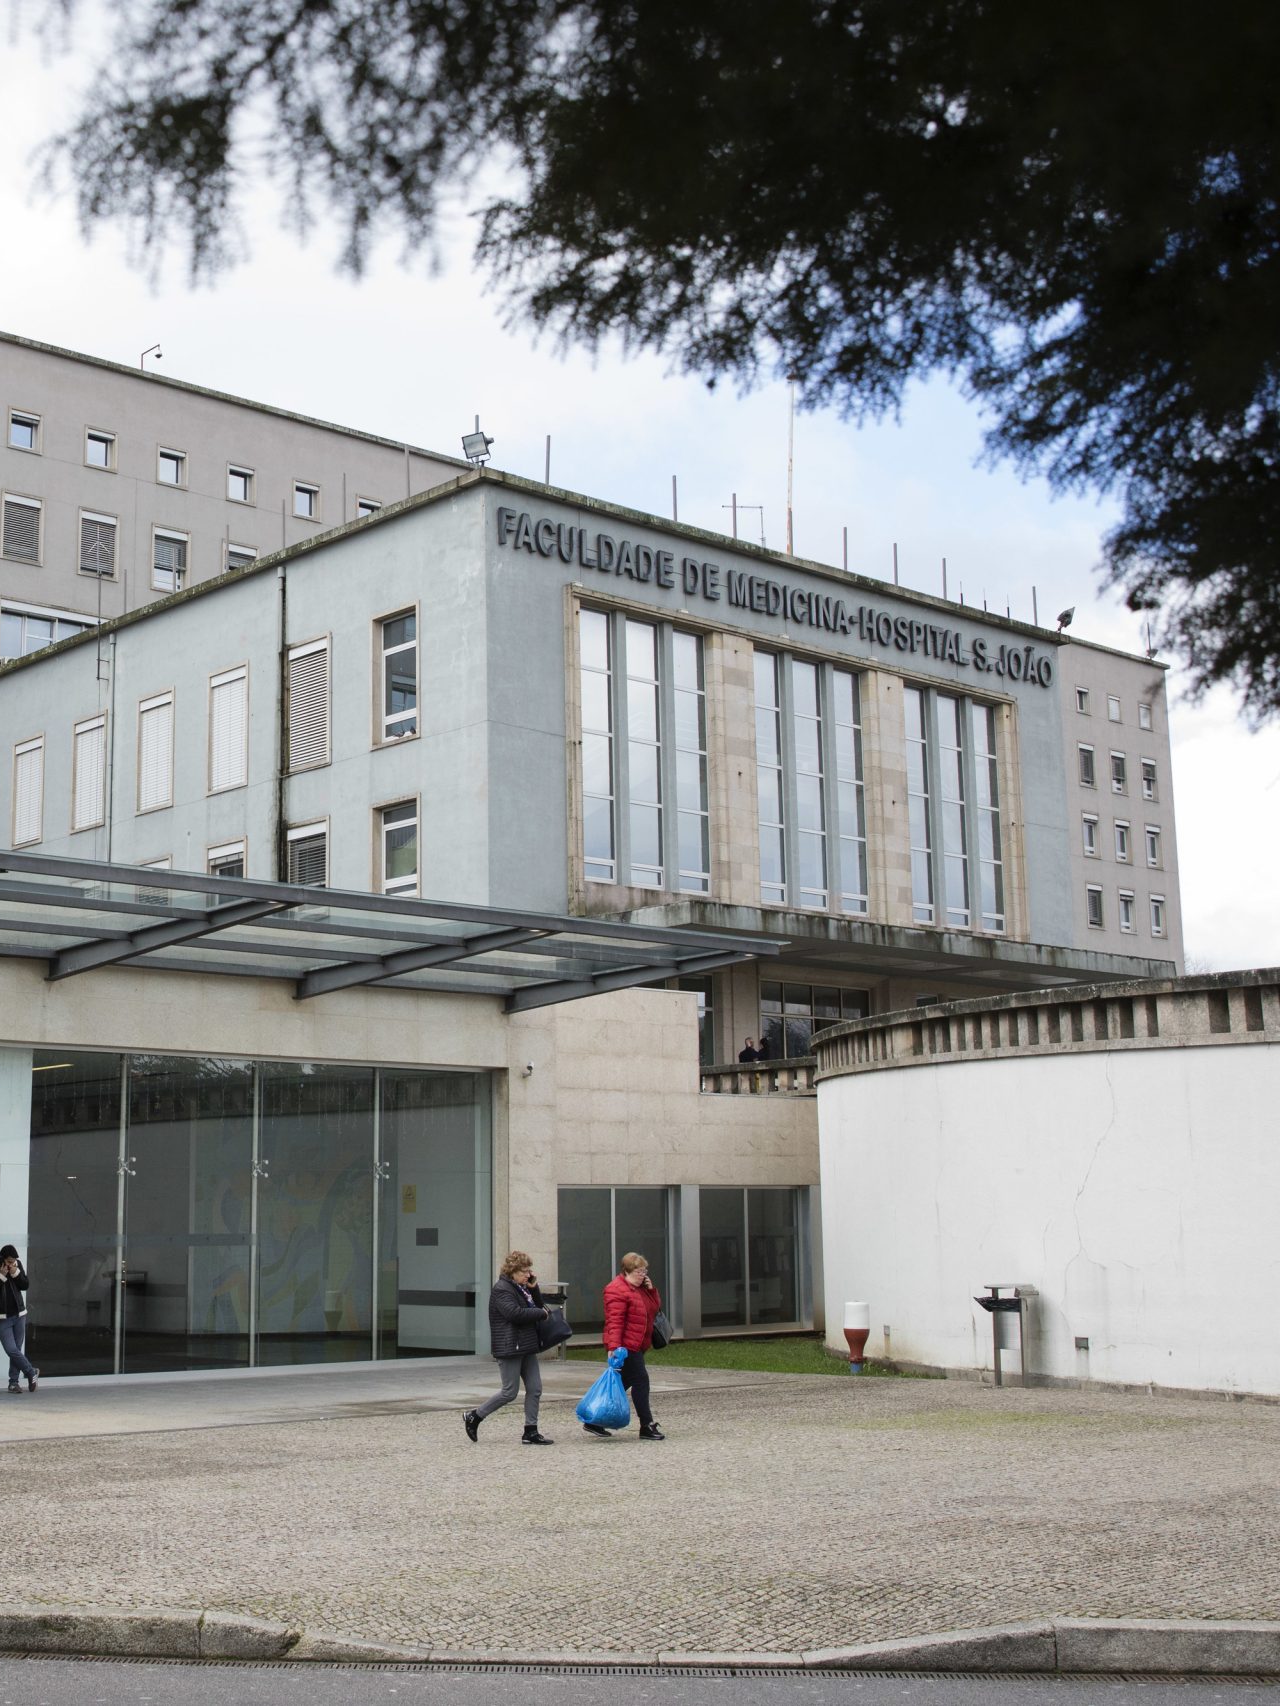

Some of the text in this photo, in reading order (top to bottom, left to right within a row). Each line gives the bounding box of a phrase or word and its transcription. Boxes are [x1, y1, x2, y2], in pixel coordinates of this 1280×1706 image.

[498, 507, 675, 588] FACULDADE
[683, 557, 720, 601] DE
[973, 637, 994, 673] S.
[996, 644, 1054, 689] JOÃO
